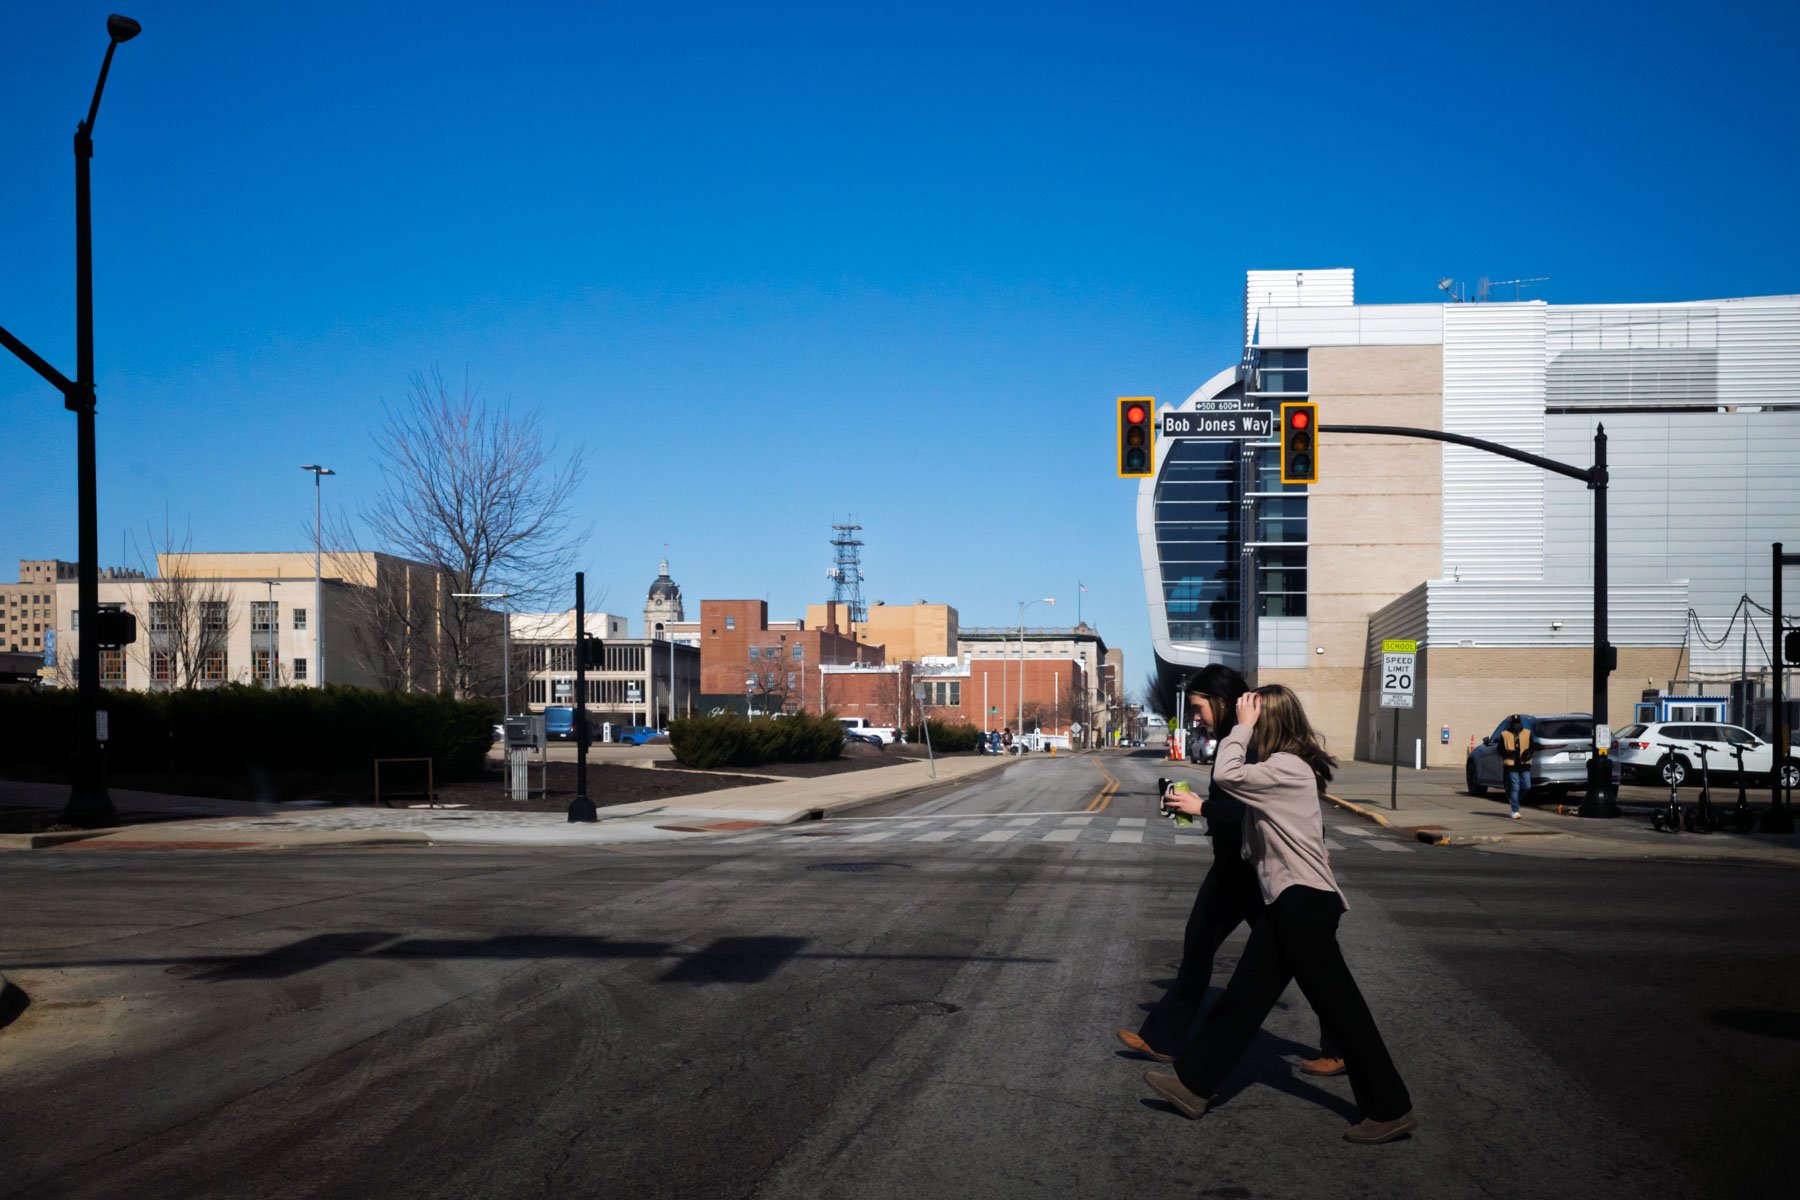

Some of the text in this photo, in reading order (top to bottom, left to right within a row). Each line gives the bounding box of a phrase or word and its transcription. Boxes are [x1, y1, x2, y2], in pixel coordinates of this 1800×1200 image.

[1166, 417, 1268, 434] Bob Jones Way
[1385, 674, 1411, 689] 20
